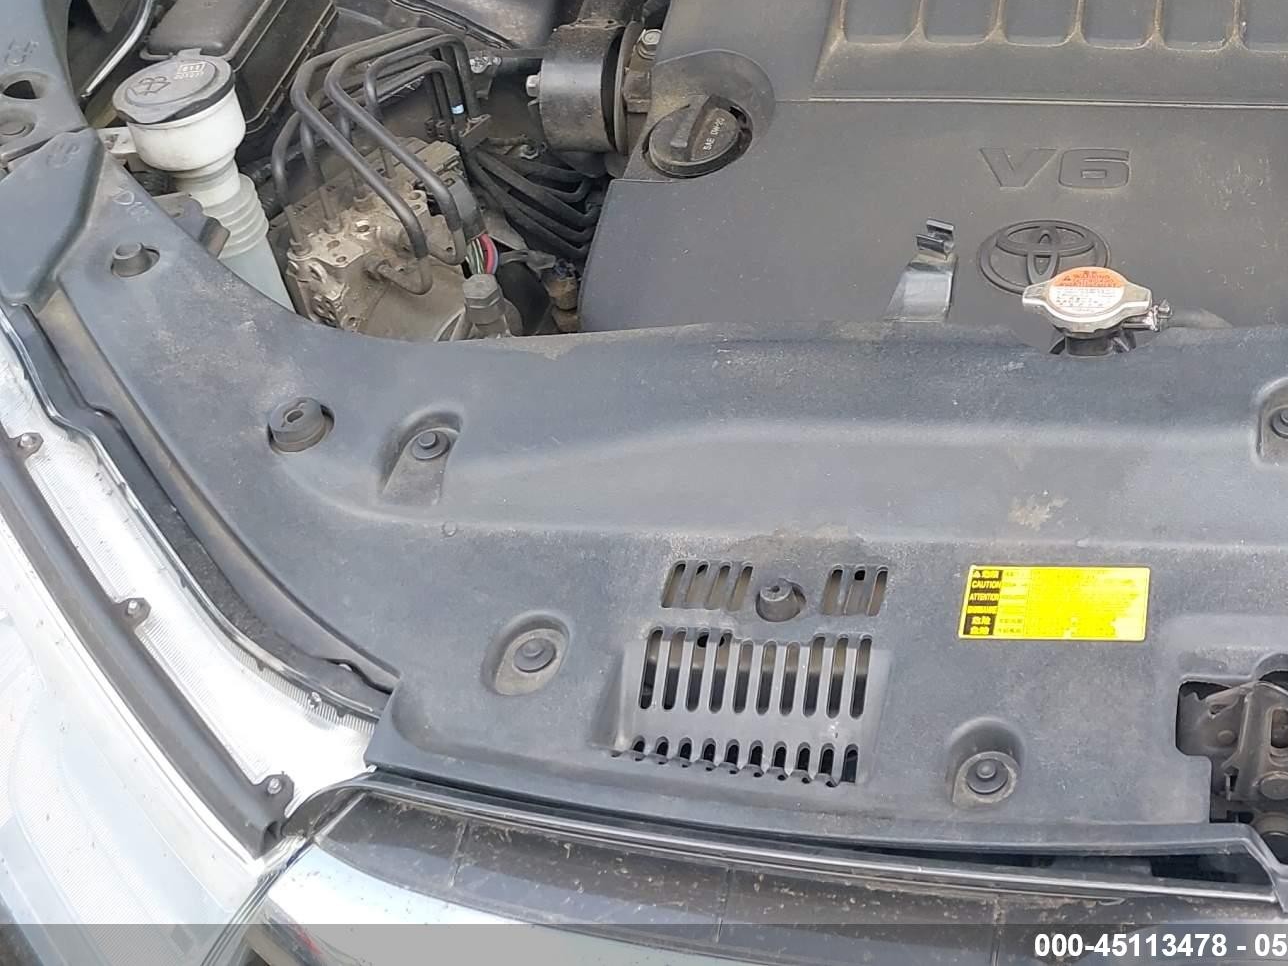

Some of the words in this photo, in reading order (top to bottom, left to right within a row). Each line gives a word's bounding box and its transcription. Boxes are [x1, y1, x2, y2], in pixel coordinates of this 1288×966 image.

[702, 136, 716, 152] SAE
[978, 147, 1133, 189] V6
[971, 580, 1002, 589] CAUTION
[969, 593, 1000, 601] ATTENTION
